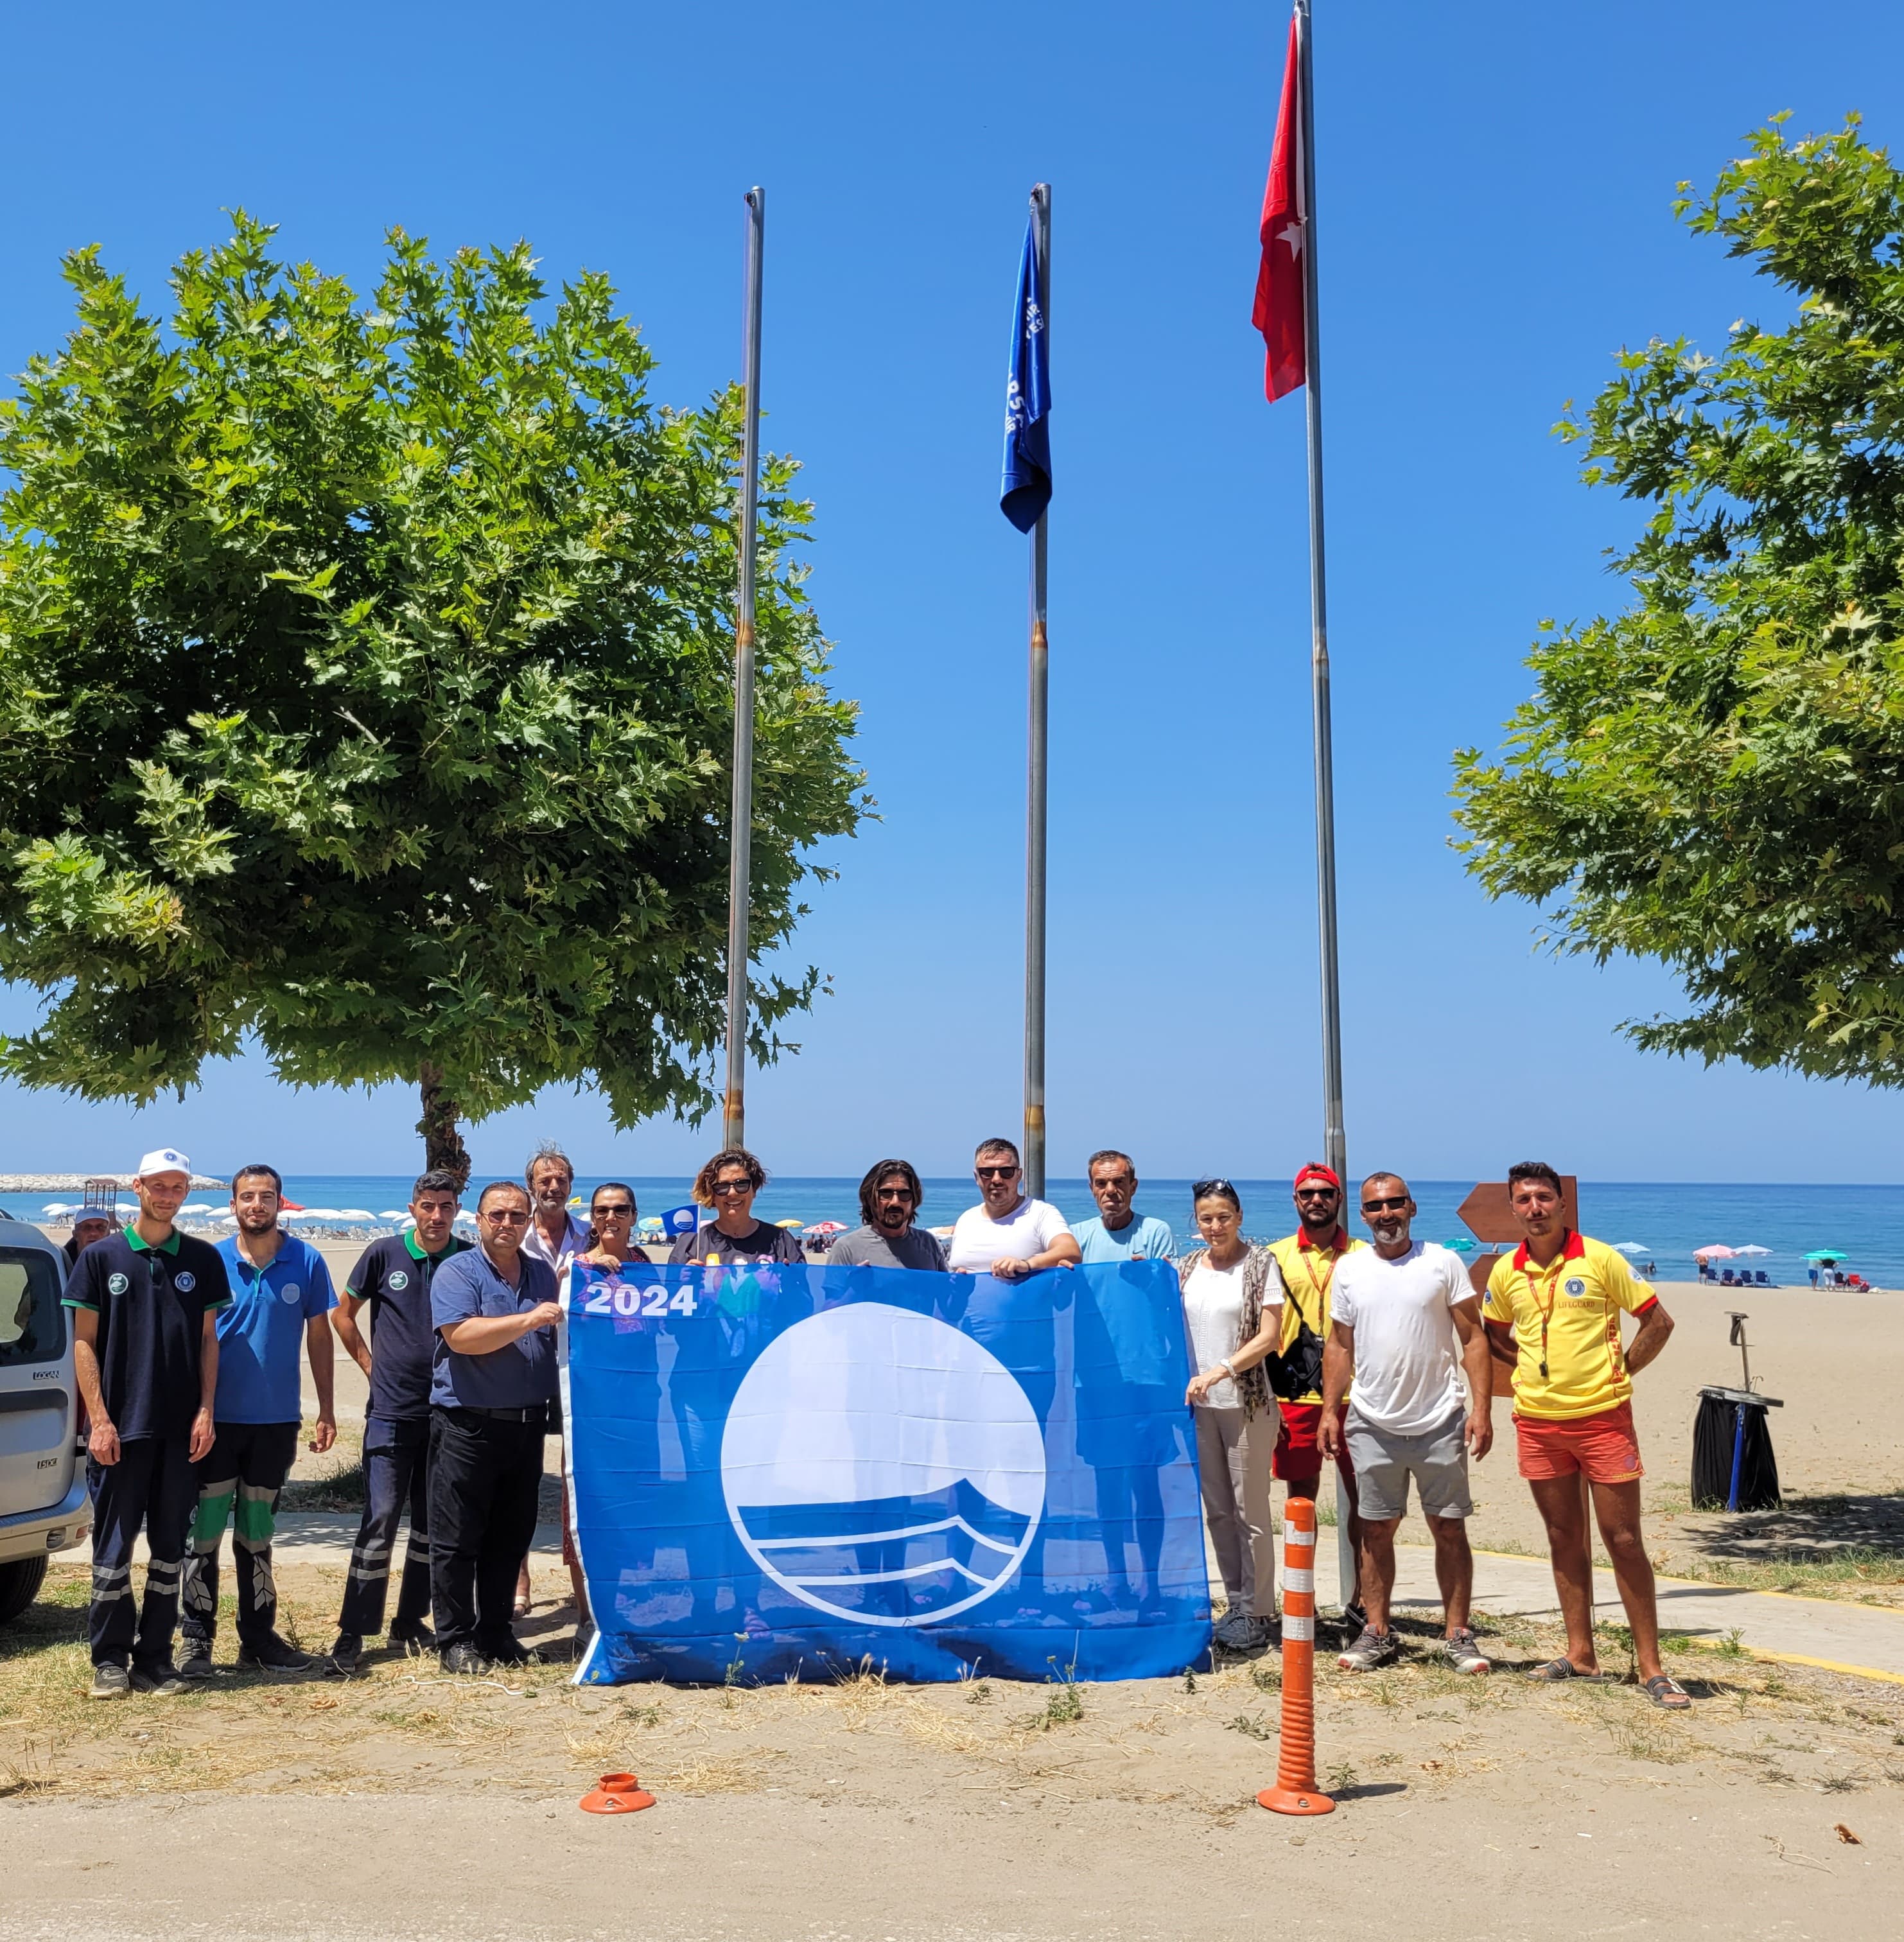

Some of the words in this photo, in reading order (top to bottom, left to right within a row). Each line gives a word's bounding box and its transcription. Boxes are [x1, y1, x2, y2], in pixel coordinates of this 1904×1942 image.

[584, 1281, 698, 1317] 2024
[1557, 1299, 1596, 1309] LIFEGUARD
[33, 1370, 60, 1381] LOGAN
